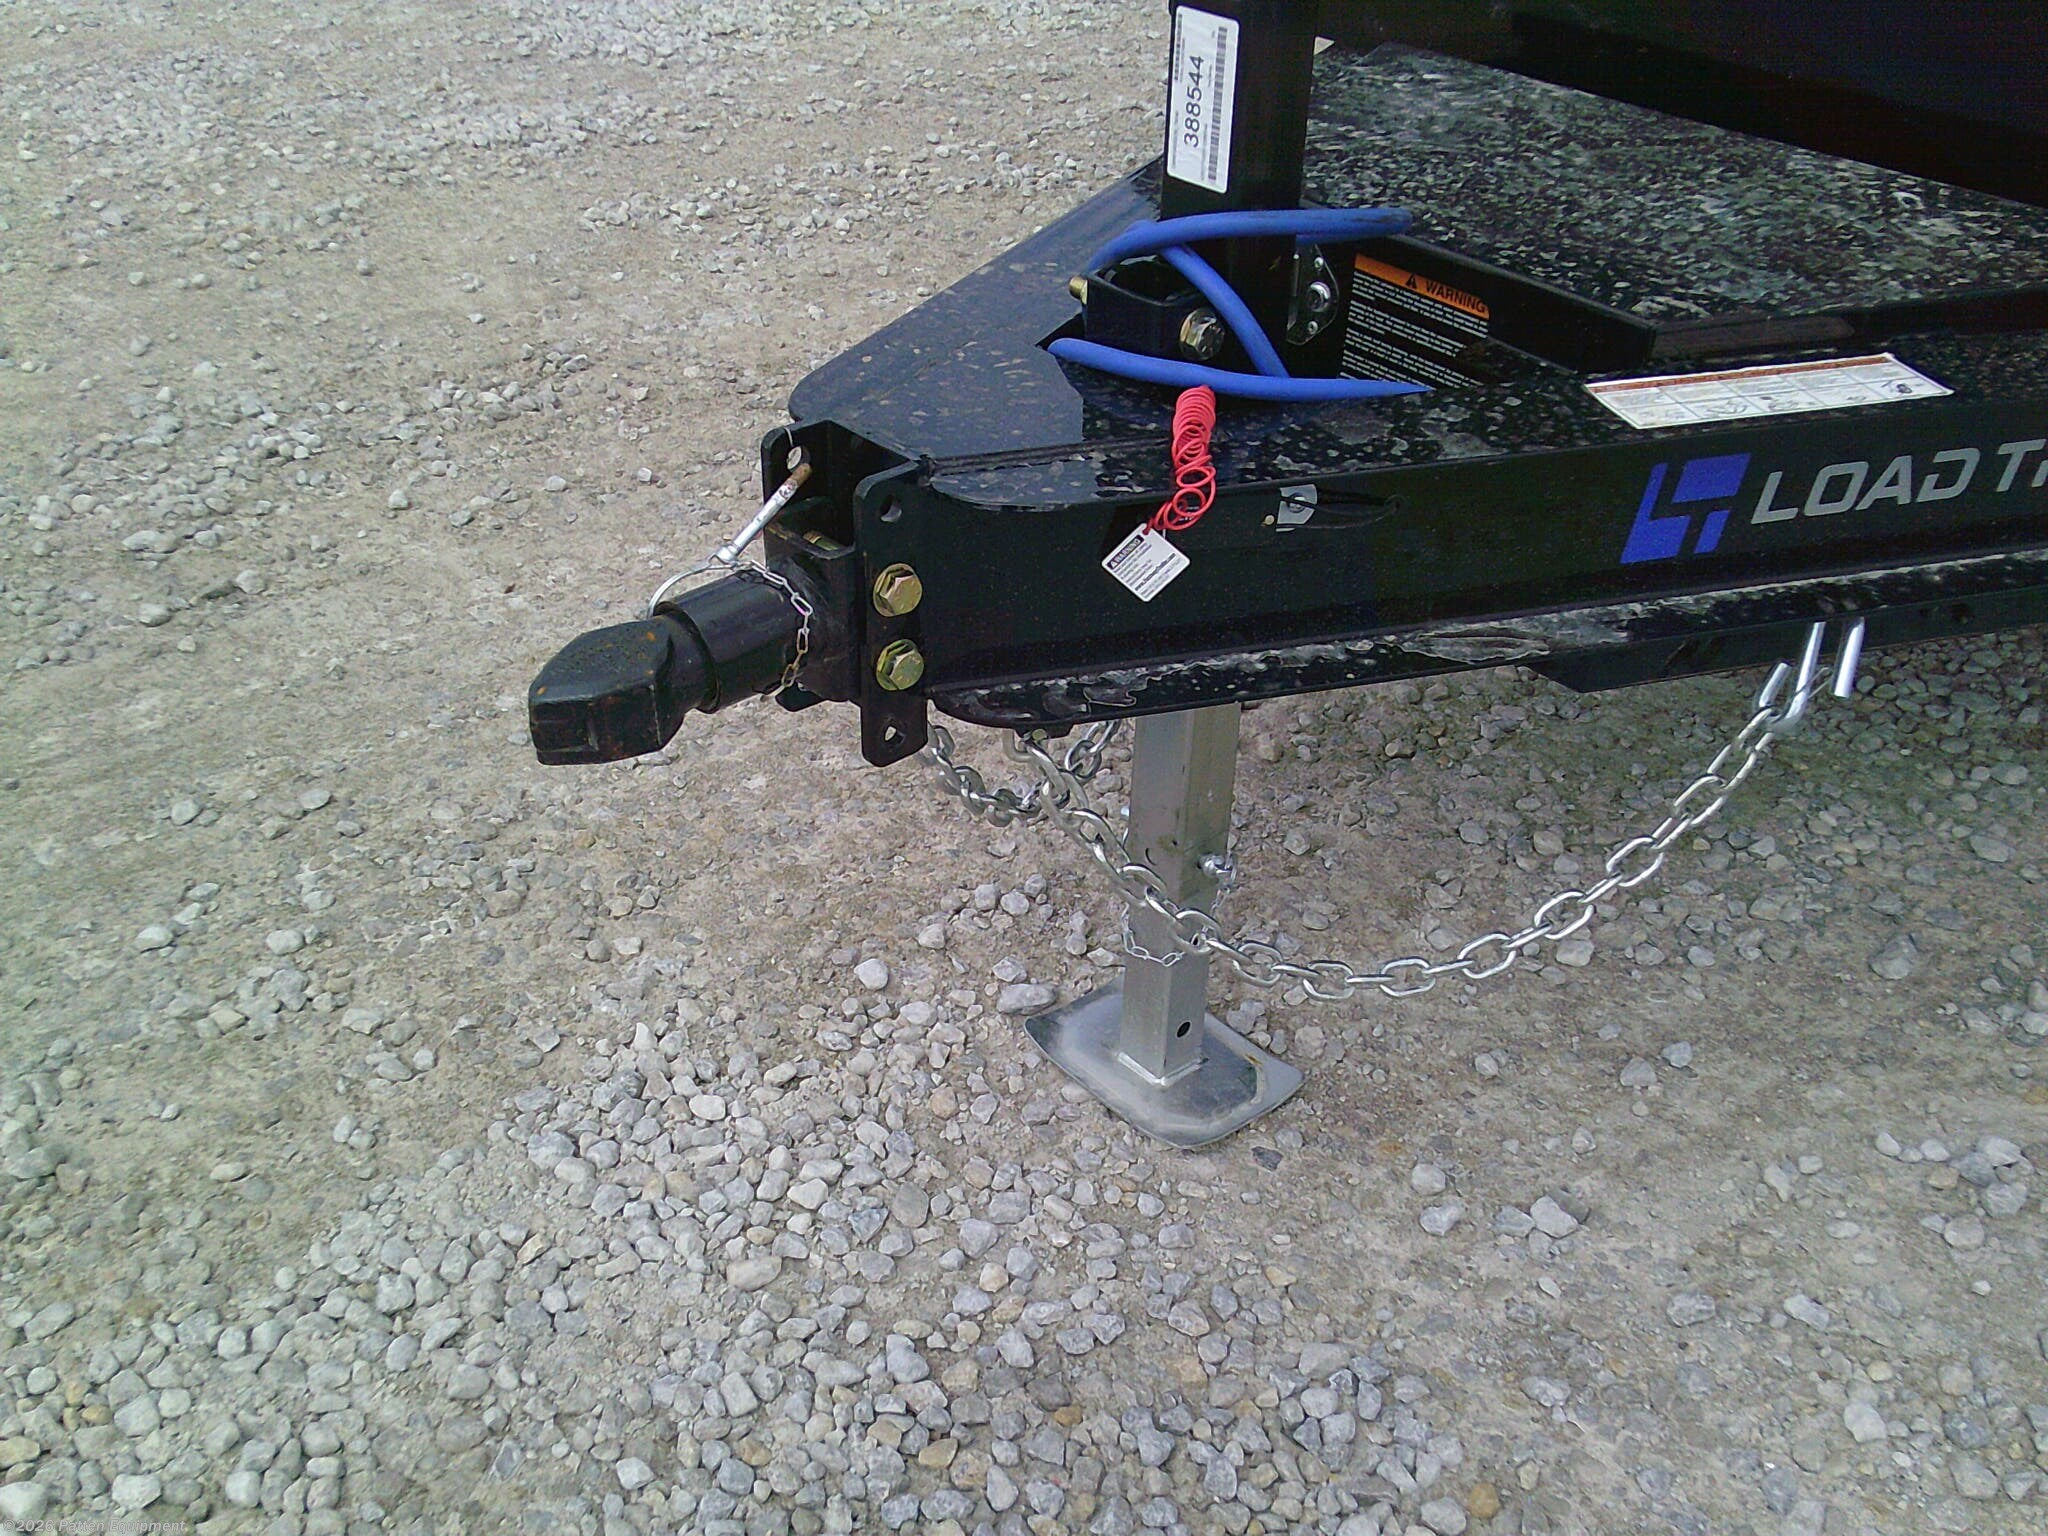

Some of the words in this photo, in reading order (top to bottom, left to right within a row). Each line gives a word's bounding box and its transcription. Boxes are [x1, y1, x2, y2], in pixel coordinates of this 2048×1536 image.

[1184, 55, 1204, 148] 388544
[1426, 279, 1486, 314] WARNING
[1750, 447, 1981, 525] LOAD
